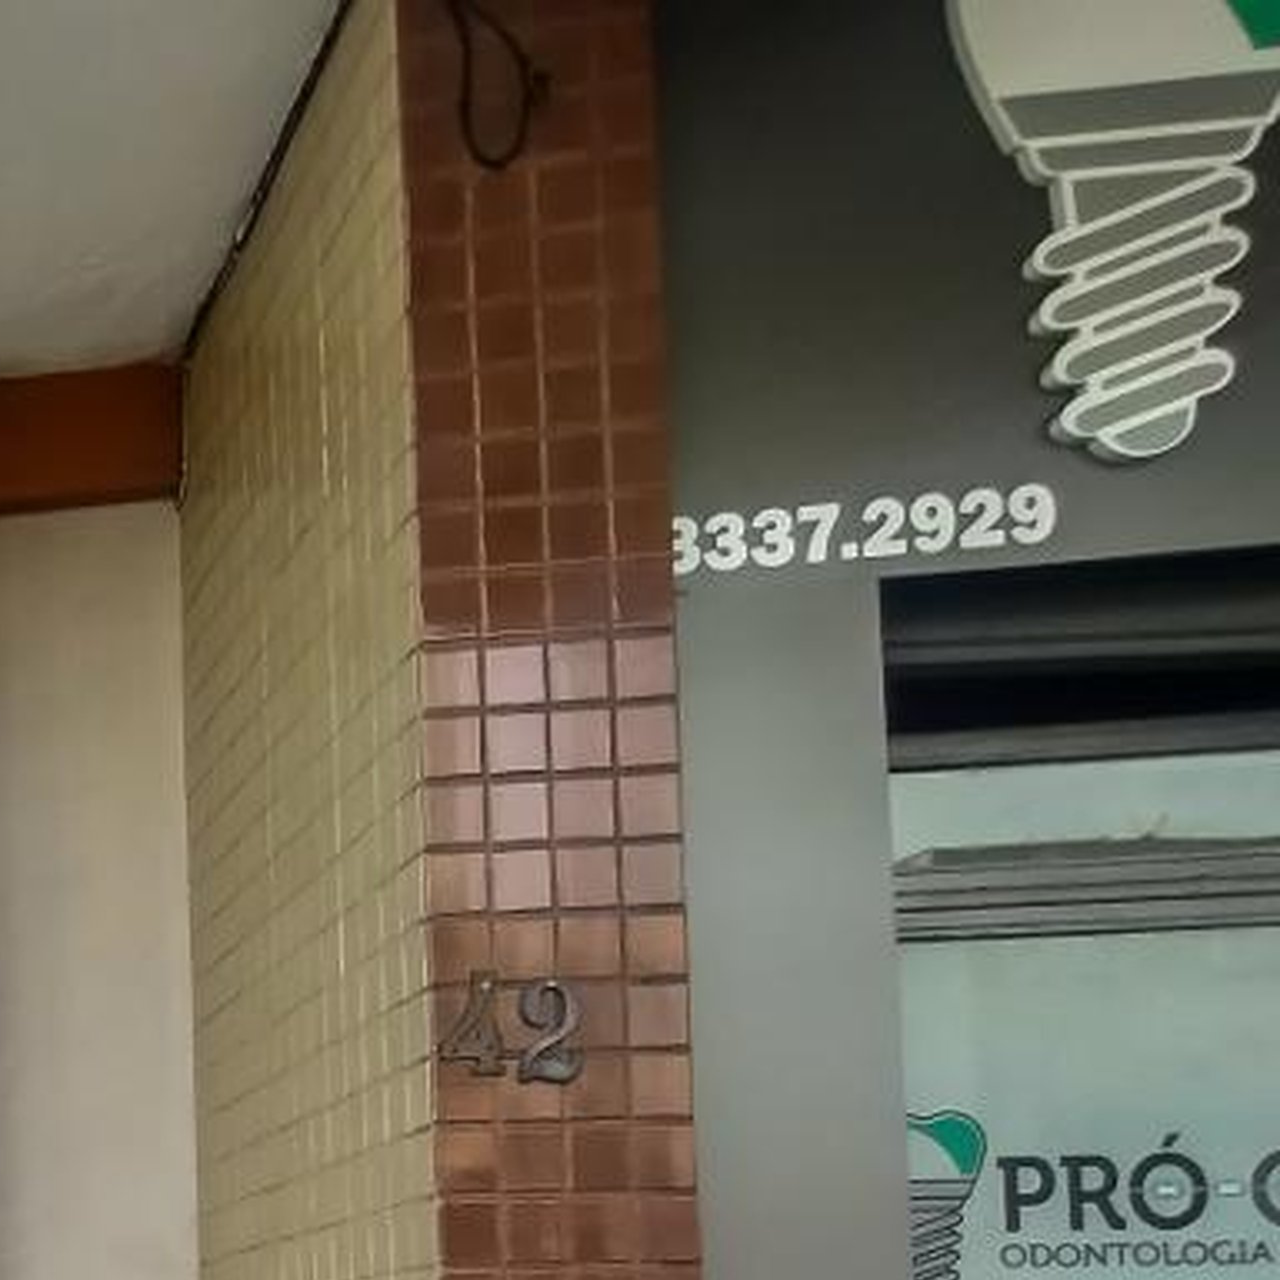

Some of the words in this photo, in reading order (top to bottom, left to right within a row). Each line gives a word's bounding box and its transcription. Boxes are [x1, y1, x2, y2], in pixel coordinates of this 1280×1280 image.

[672, 484, 1058, 574] 3337.2929
[437, 970, 586, 1085] 42
[1000, 1240, 1275, 1269] ODONTOLOGIA
